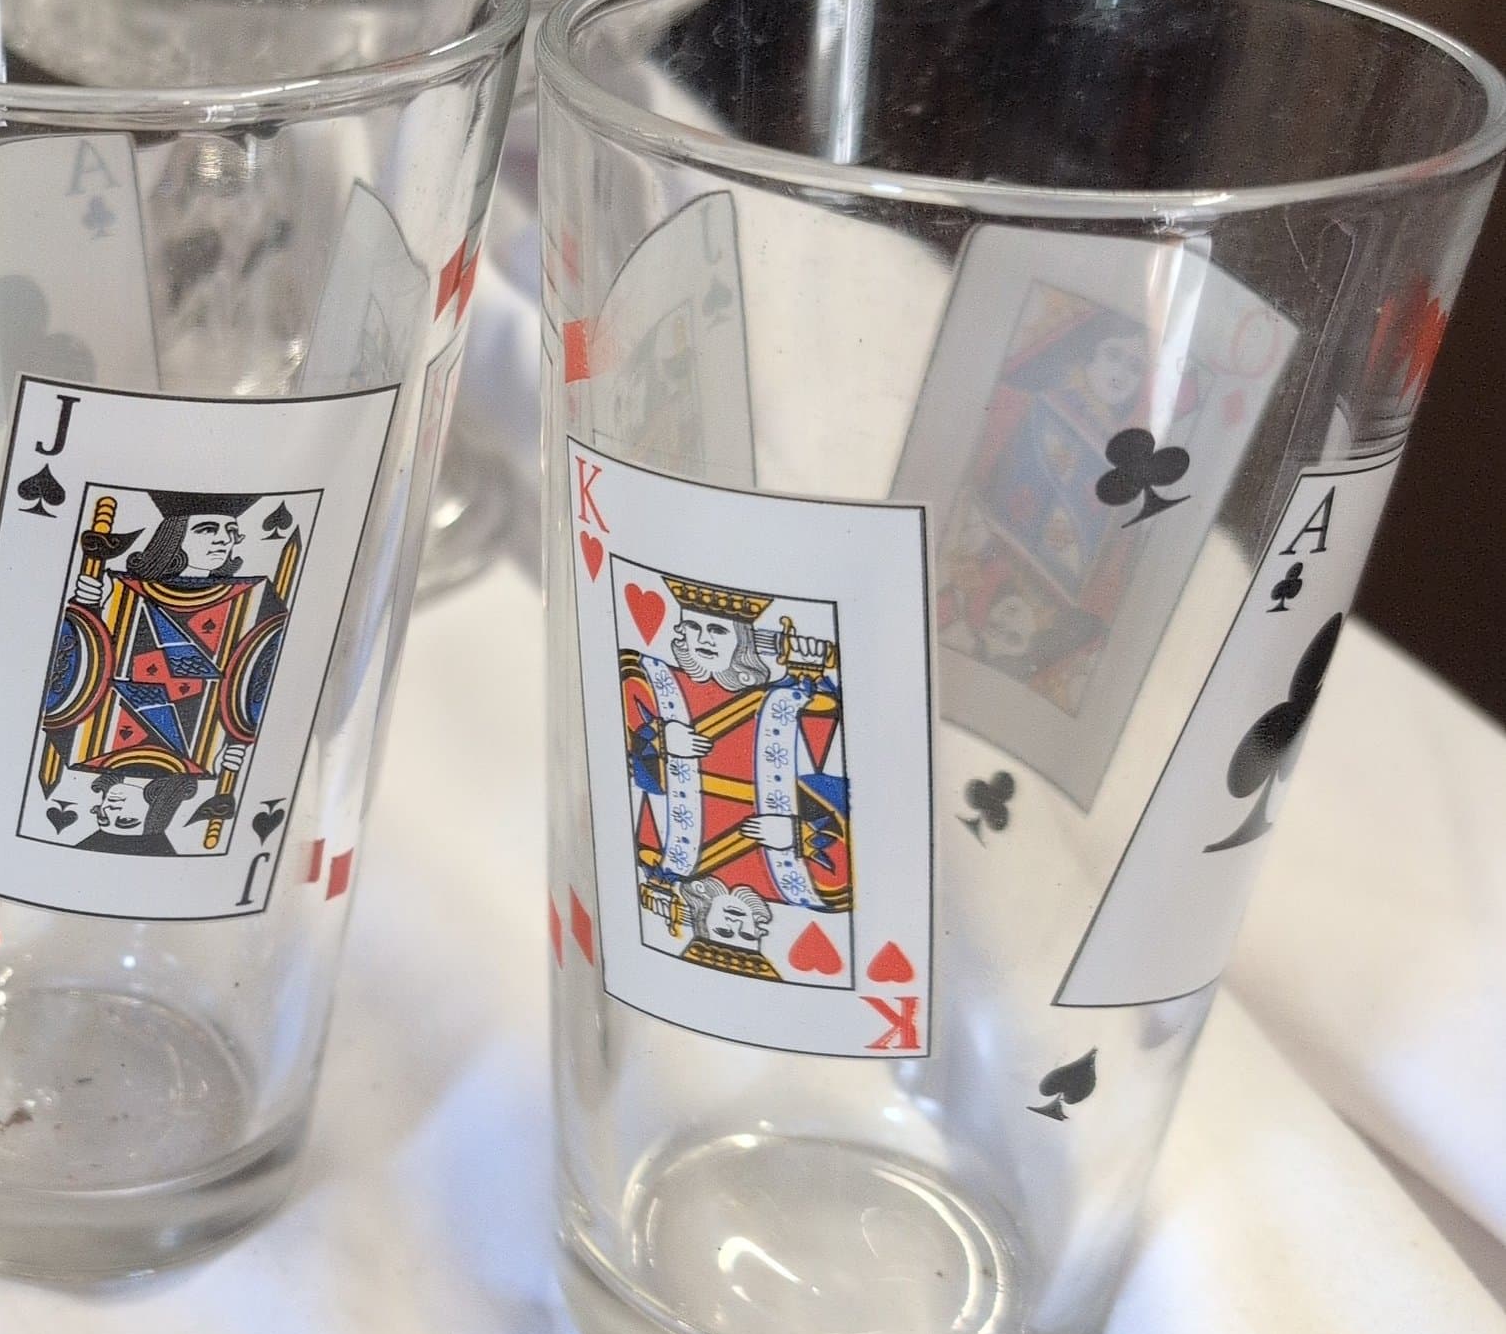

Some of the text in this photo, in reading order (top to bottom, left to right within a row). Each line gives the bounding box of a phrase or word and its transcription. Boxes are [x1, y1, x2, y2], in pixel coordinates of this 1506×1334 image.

[34, 395, 81, 458] J
[574, 454, 611, 535] K
[1279, 484, 1340, 556] A
[234, 851, 271, 908] J
[858, 994, 922, 1051] K
